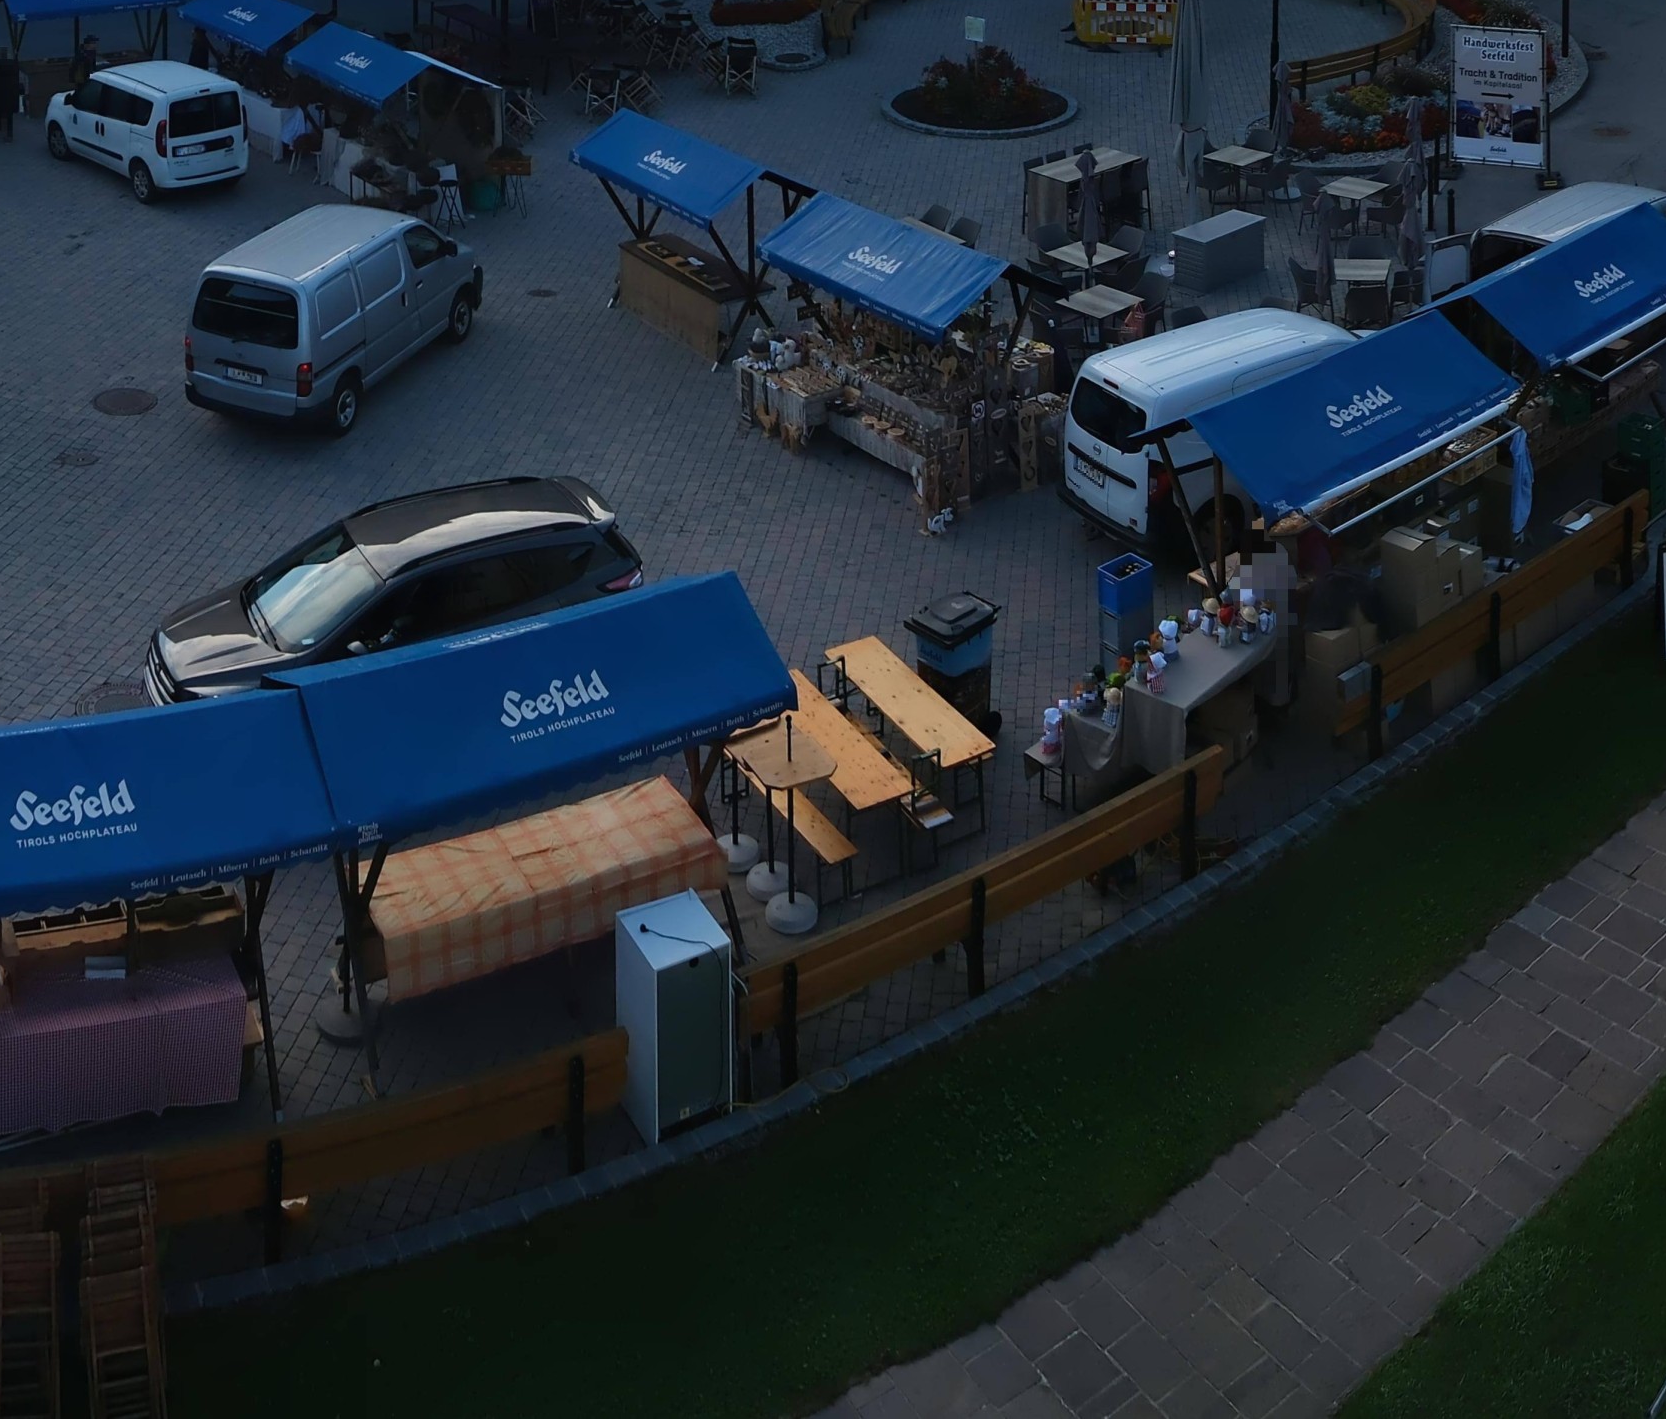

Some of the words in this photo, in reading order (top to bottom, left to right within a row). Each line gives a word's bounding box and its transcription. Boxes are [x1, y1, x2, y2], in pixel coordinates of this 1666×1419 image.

[1464, 37, 1534, 52] Handwerksfest
[1482, 50, 1515, 62] Seefeld
[1459, 68, 1489, 79] Tracht
[1490, 70, 1496, 79] &
[1498, 70, 1537, 83] Tradition
[848, 246, 903, 274] Seefeld
[1574, 263, 1625, 298] Seefeld
[1326, 385, 1393, 428] Seefeld
[500, 669, 610, 729] Seefeld
[510, 727, 545, 744] TIROLS
[548, 706, 615, 735] HOCHPLATEAU
[618, 747, 643, 764] Seefeld
[652, 735, 682, 753] Leutasch
[692, 725, 718, 739] Mösern
[726, 716, 745, 728] Reith
[752, 701, 784, 718] Scharnitz
[9, 779, 135, 832] Seefeld
[17, 835, 55, 849] TIROLS
[60, 823, 137, 843] HOCHPLATEAU
[131, 879, 158, 891] Seefeld
[171, 869, 206, 884] Leutasch
[218, 862, 248, 875] Mösern
[259, 853, 280, 866] Reith
[290, 843, 329, 859] Scharnitz
